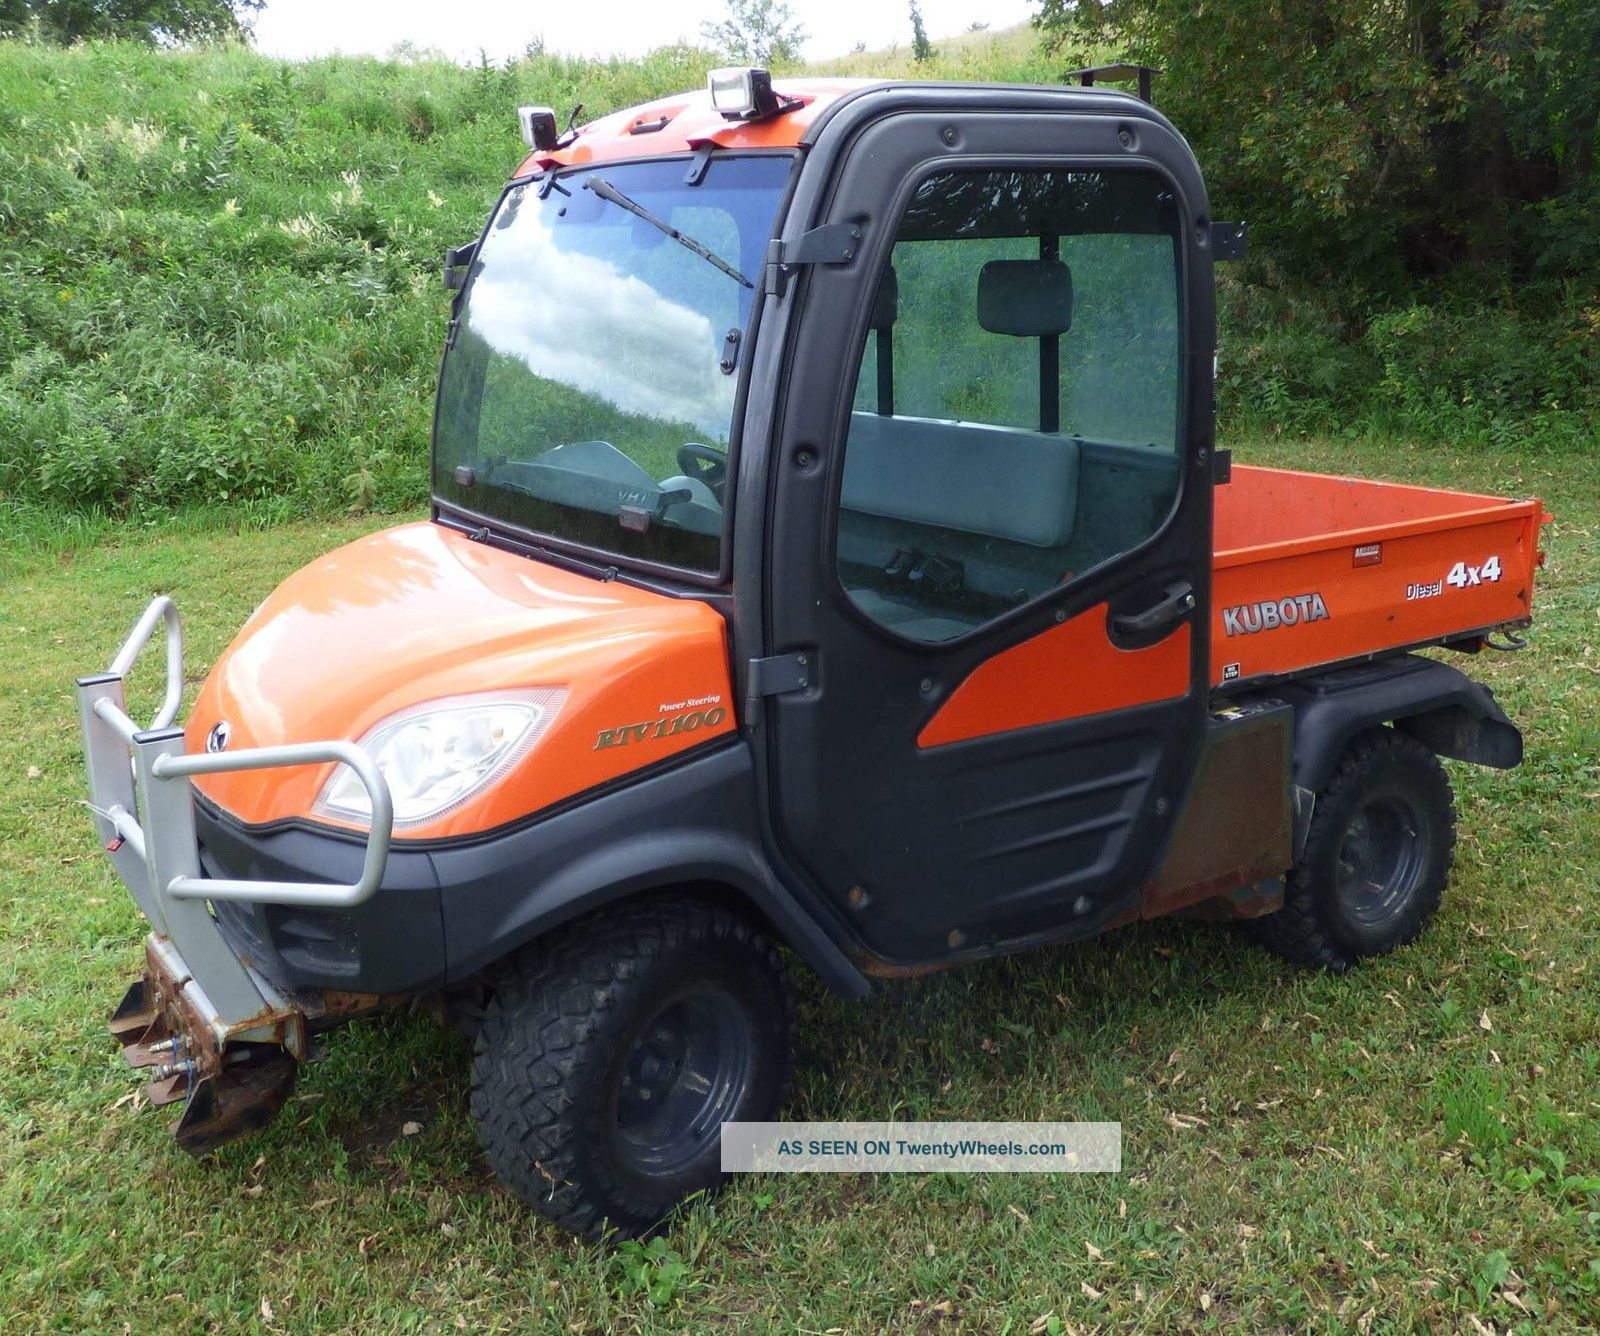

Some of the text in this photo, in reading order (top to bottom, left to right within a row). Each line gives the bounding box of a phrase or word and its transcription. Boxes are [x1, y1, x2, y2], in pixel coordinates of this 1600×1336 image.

[1406, 555, 1502, 601] Diesel 4x4
[1222, 592, 1330, 637] KUBOTA
[659, 694, 721, 713] Power Steering
[592, 706, 726, 752] RTV1100
